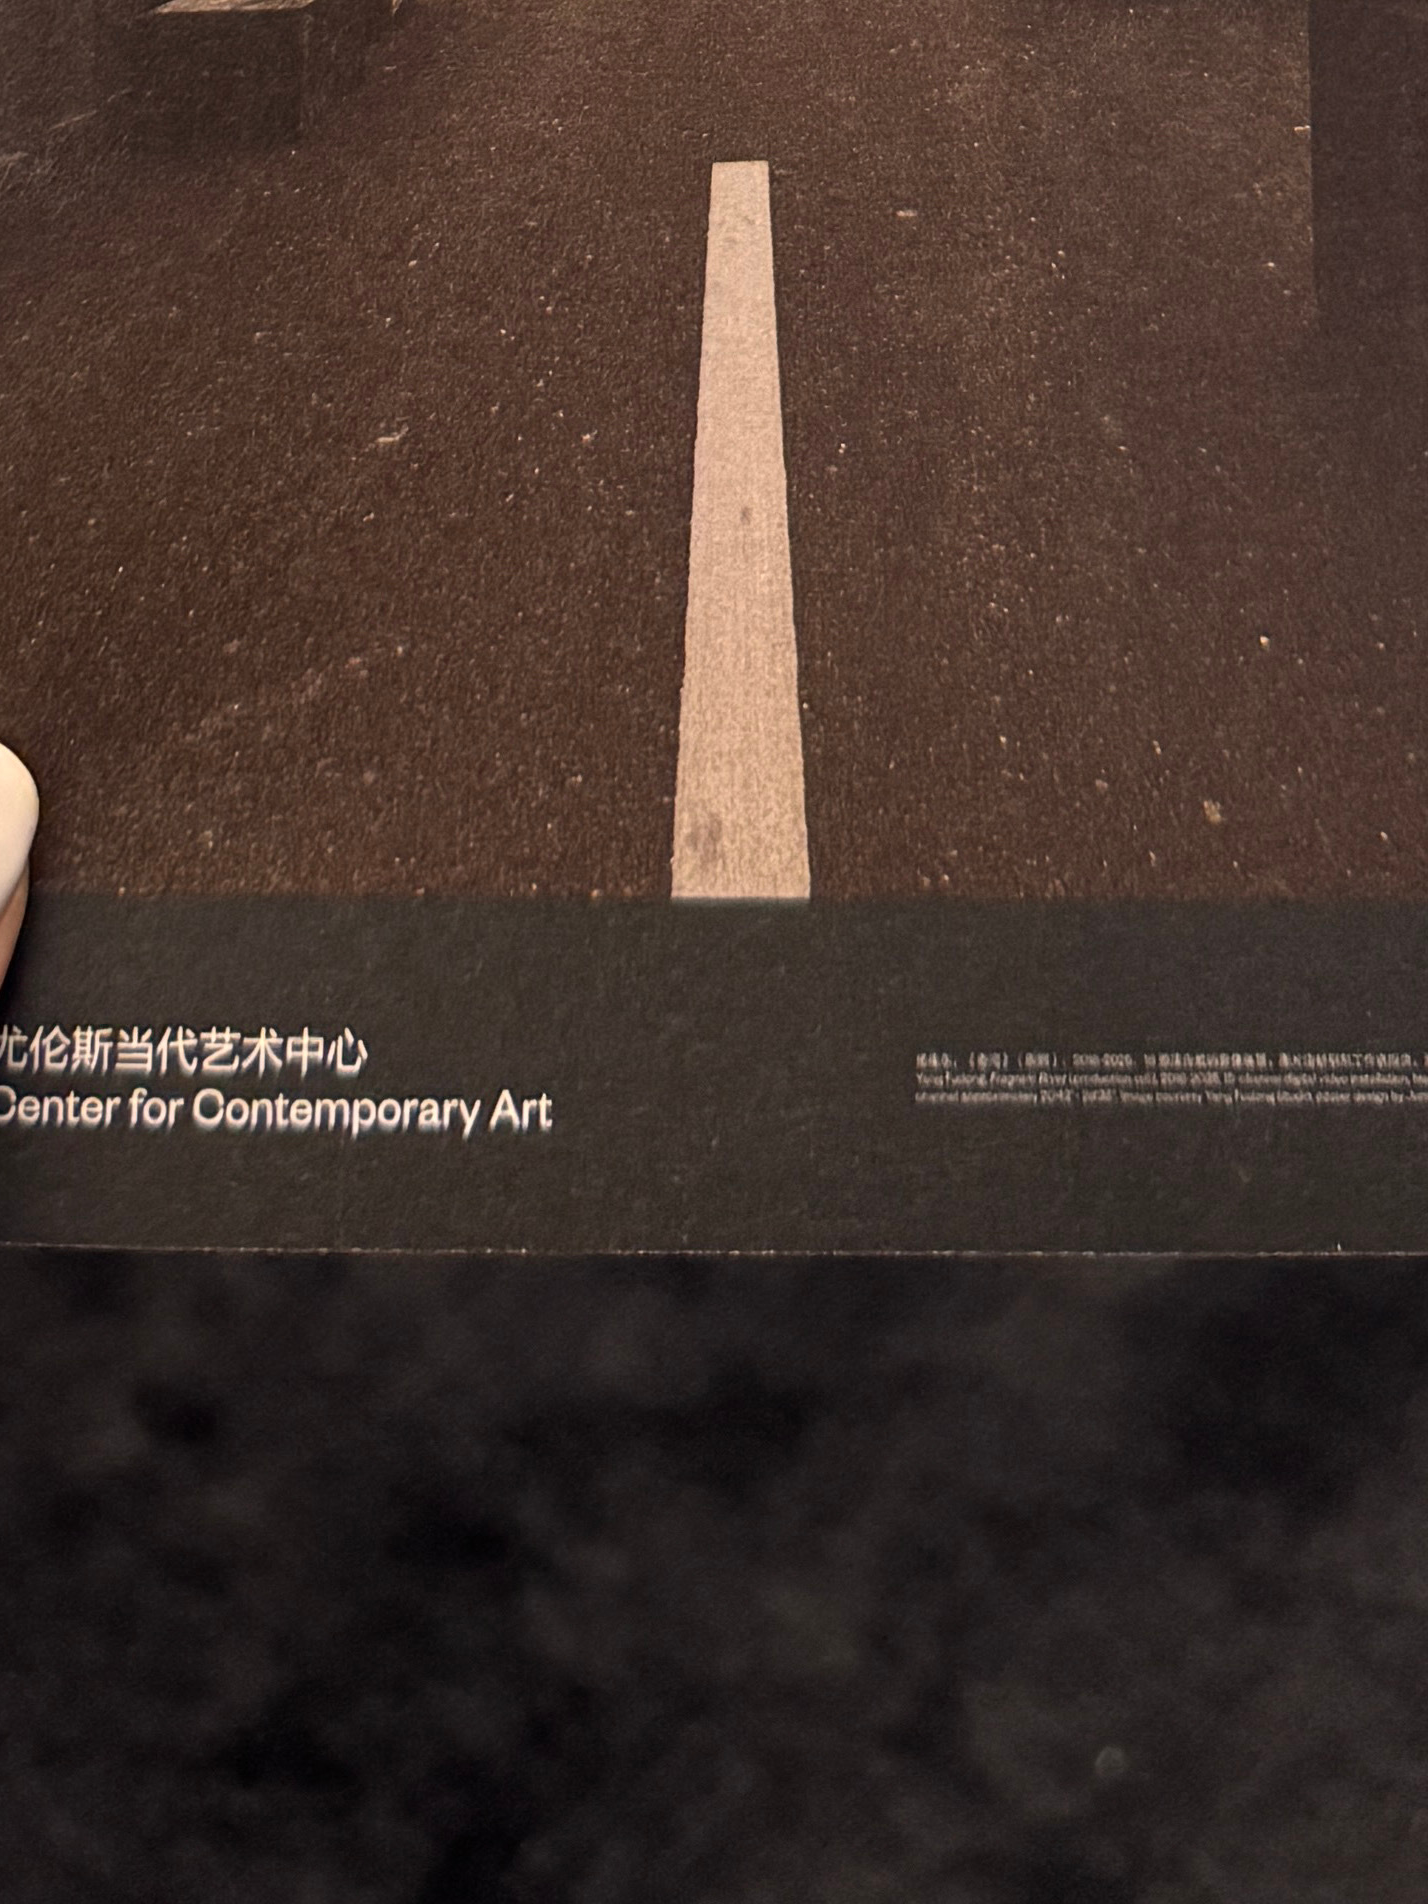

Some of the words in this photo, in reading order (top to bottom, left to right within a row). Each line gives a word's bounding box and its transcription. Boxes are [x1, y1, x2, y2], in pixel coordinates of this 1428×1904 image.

[128, 1087, 184, 1128] for
[192, 1088, 481, 1138] Contemporary
[489, 1089, 553, 1131] Art
